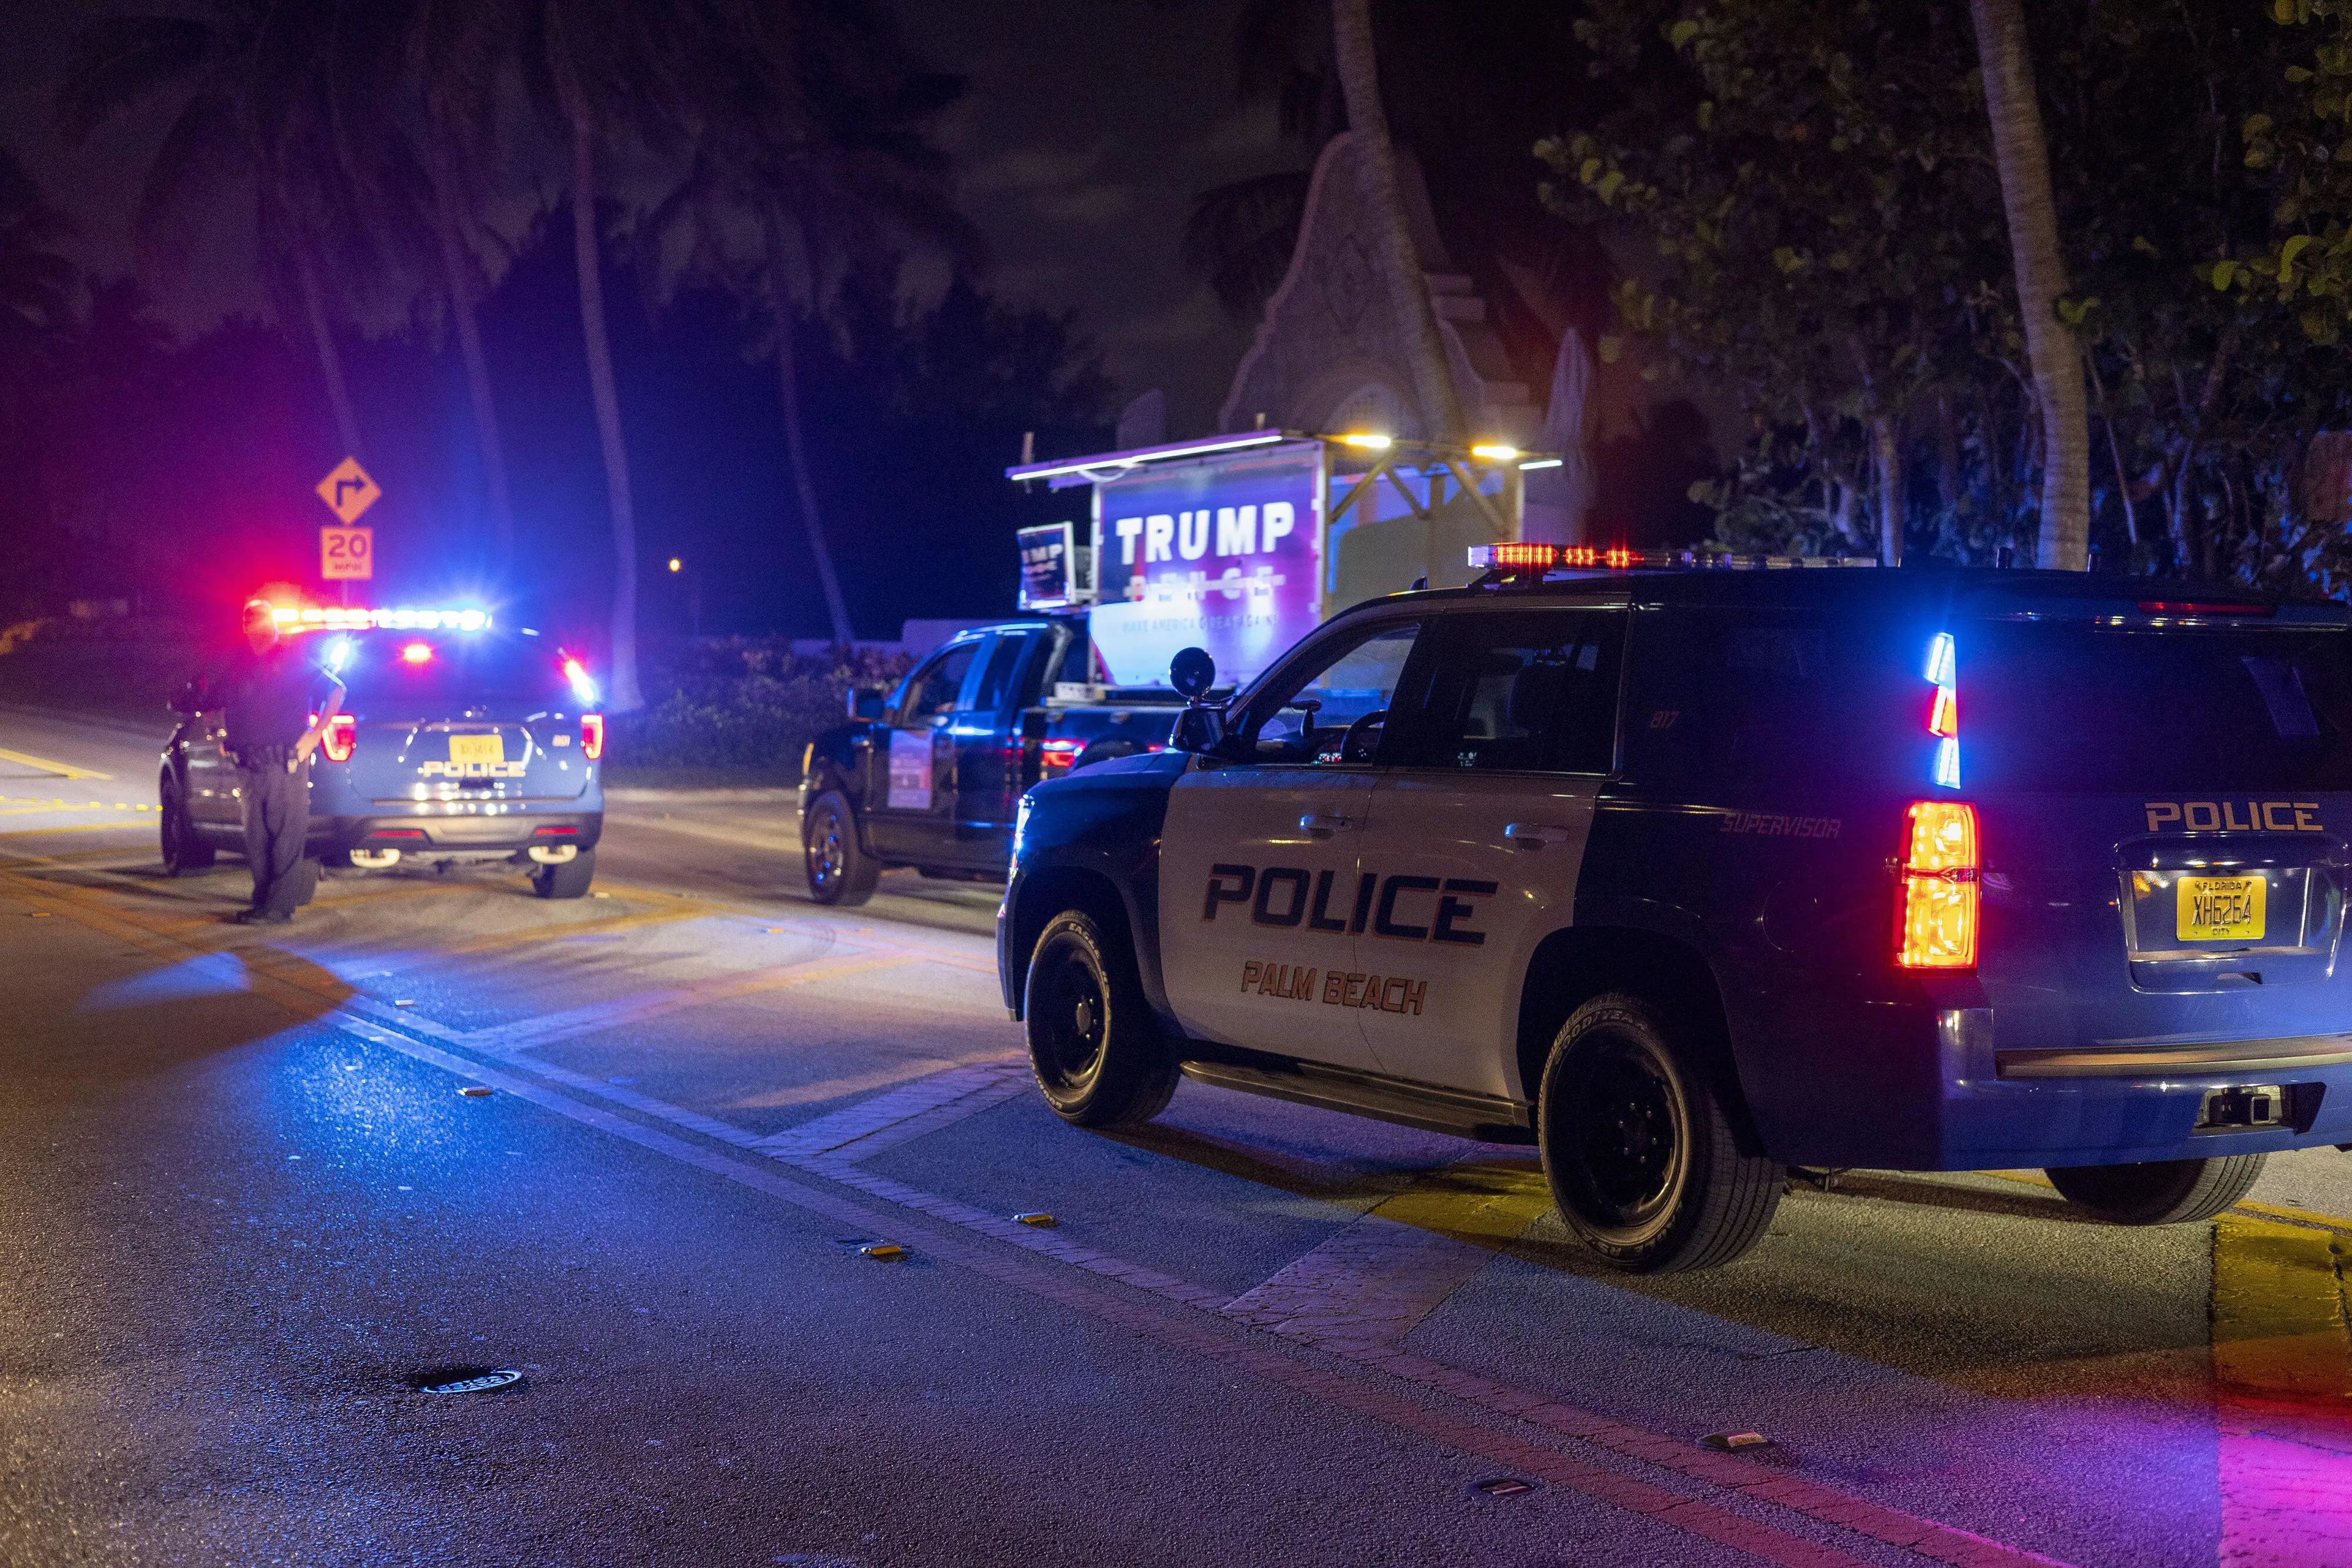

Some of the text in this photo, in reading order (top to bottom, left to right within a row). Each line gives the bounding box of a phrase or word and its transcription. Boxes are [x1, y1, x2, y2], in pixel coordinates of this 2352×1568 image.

[1115, 501, 1295, 565] TRUMP
[329, 534, 367, 559] 20
[1650, 710, 1679, 729] 817
[423, 761, 526, 778] POLICE
[1720, 813, 1841, 839] SUPERVISOR
[2144, 801, 2323, 832] POLICE
[2203, 881, 2242, 891] FLORIDA
[1204, 862, 1499, 948] POLICE
[2192, 894, 2251, 925] XH6264
[2212, 927, 2230, 935] CITY
[1240, 960, 1428, 1016] PALM BEACH
